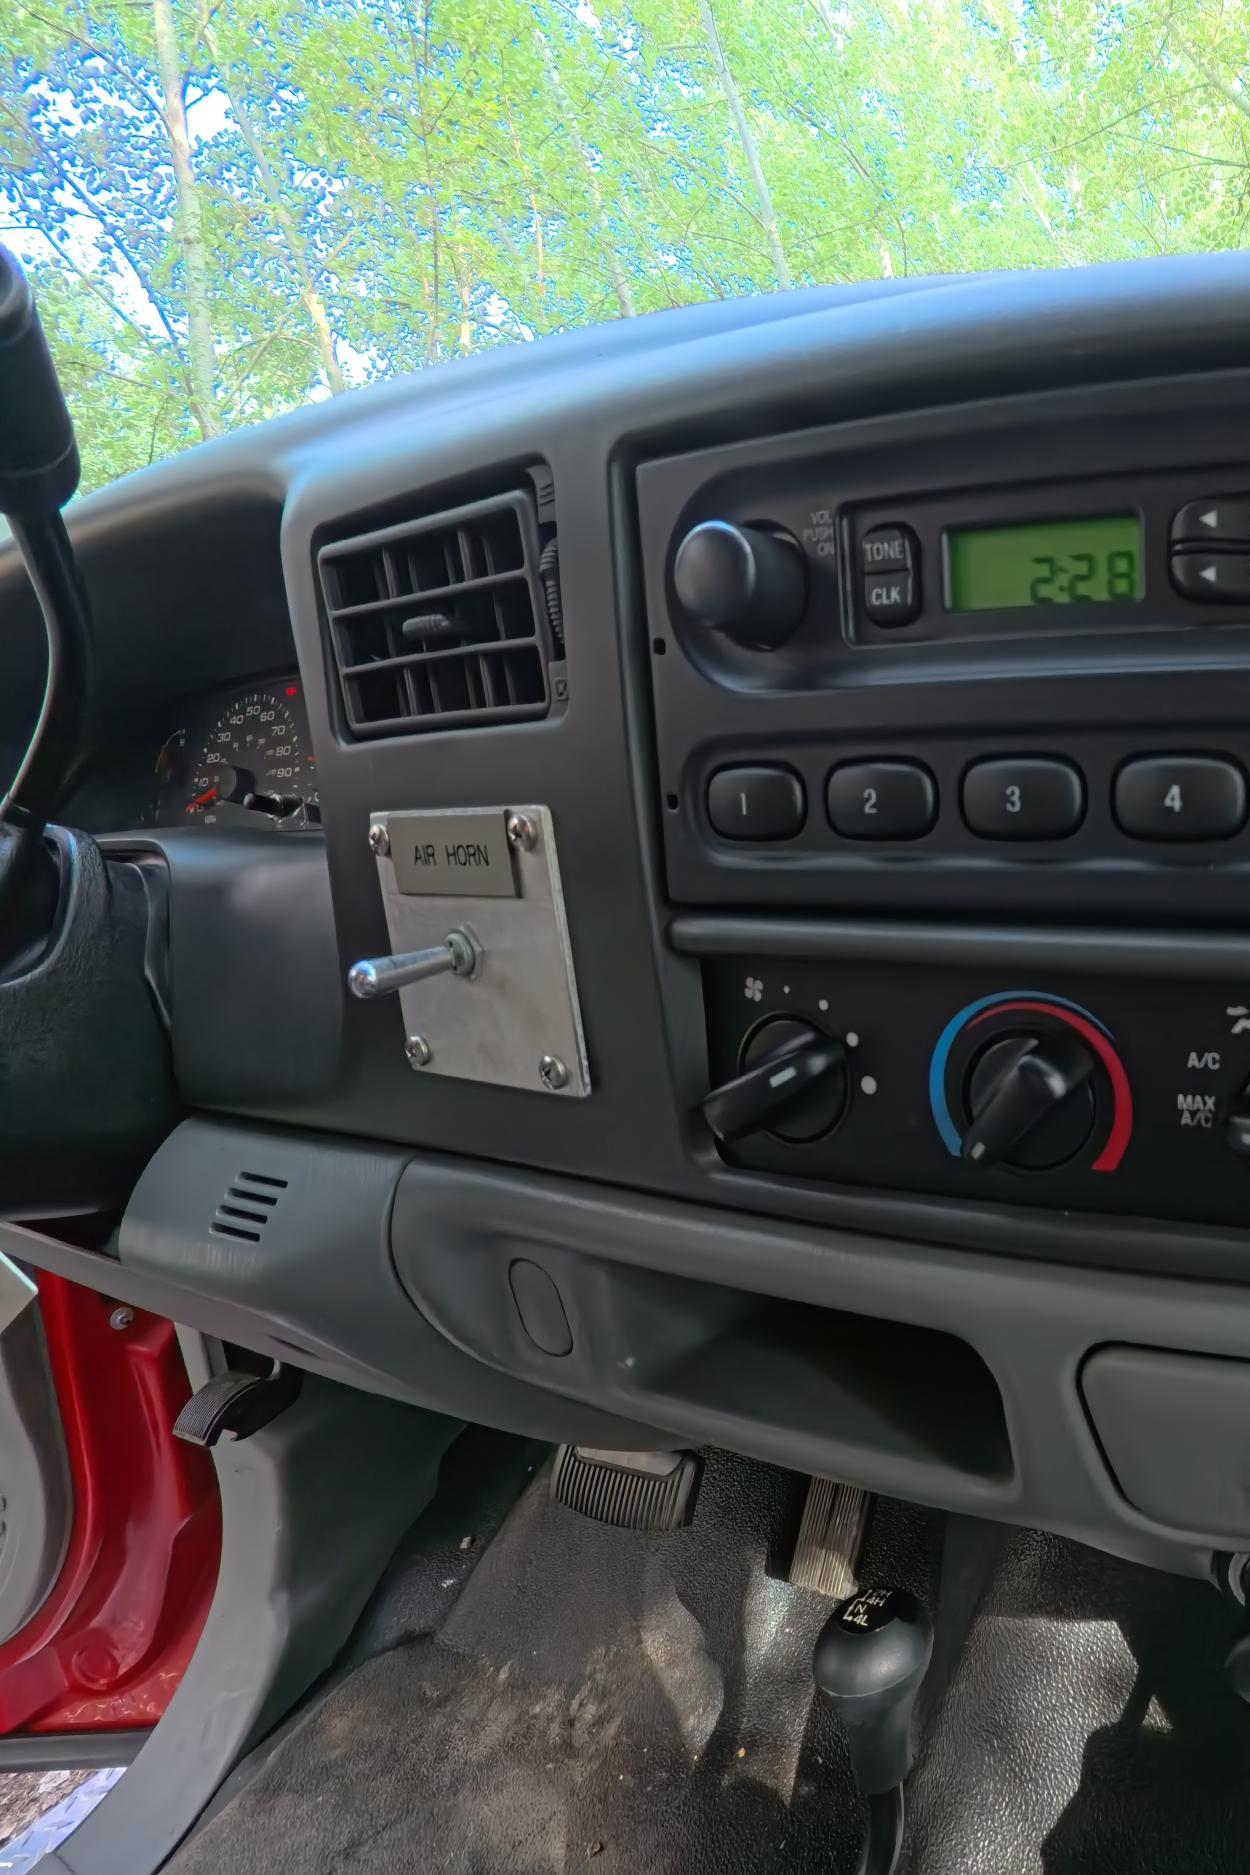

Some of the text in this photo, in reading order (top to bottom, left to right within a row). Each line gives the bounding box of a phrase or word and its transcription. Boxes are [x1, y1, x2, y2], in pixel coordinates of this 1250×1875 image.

[864, 541, 904, 561] TONE
[1030, 551, 1135, 603] 2:28
[872, 586, 900, 605] CLK
[246, 705, 261, 716] 50
[260, 711, 275, 722] 60
[229, 715, 244, 725] 40
[271, 725, 286, 736] 70
[217, 732, 231, 742] 30
[275, 746, 291, 757] 80
[206, 753, 220, 763] 20
[276, 767, 292, 778] 90
[199, 777, 209, 787] 10
[863, 788, 878, 814] 2
[1005, 785, 1021, 812] 3
[1163, 784, 1183, 813] 4
[414, 844, 490, 867] AIR HORN
[1187, 1051, 1220, 1070] A/C
[1177, 1093, 1216, 1111] MAX
[1180, 1110, 1213, 1128] A/C
[866, 1596, 886, 1607] 4H
[854, 1603, 868, 1614] N
[853, 1614, 869, 1627] 4L
